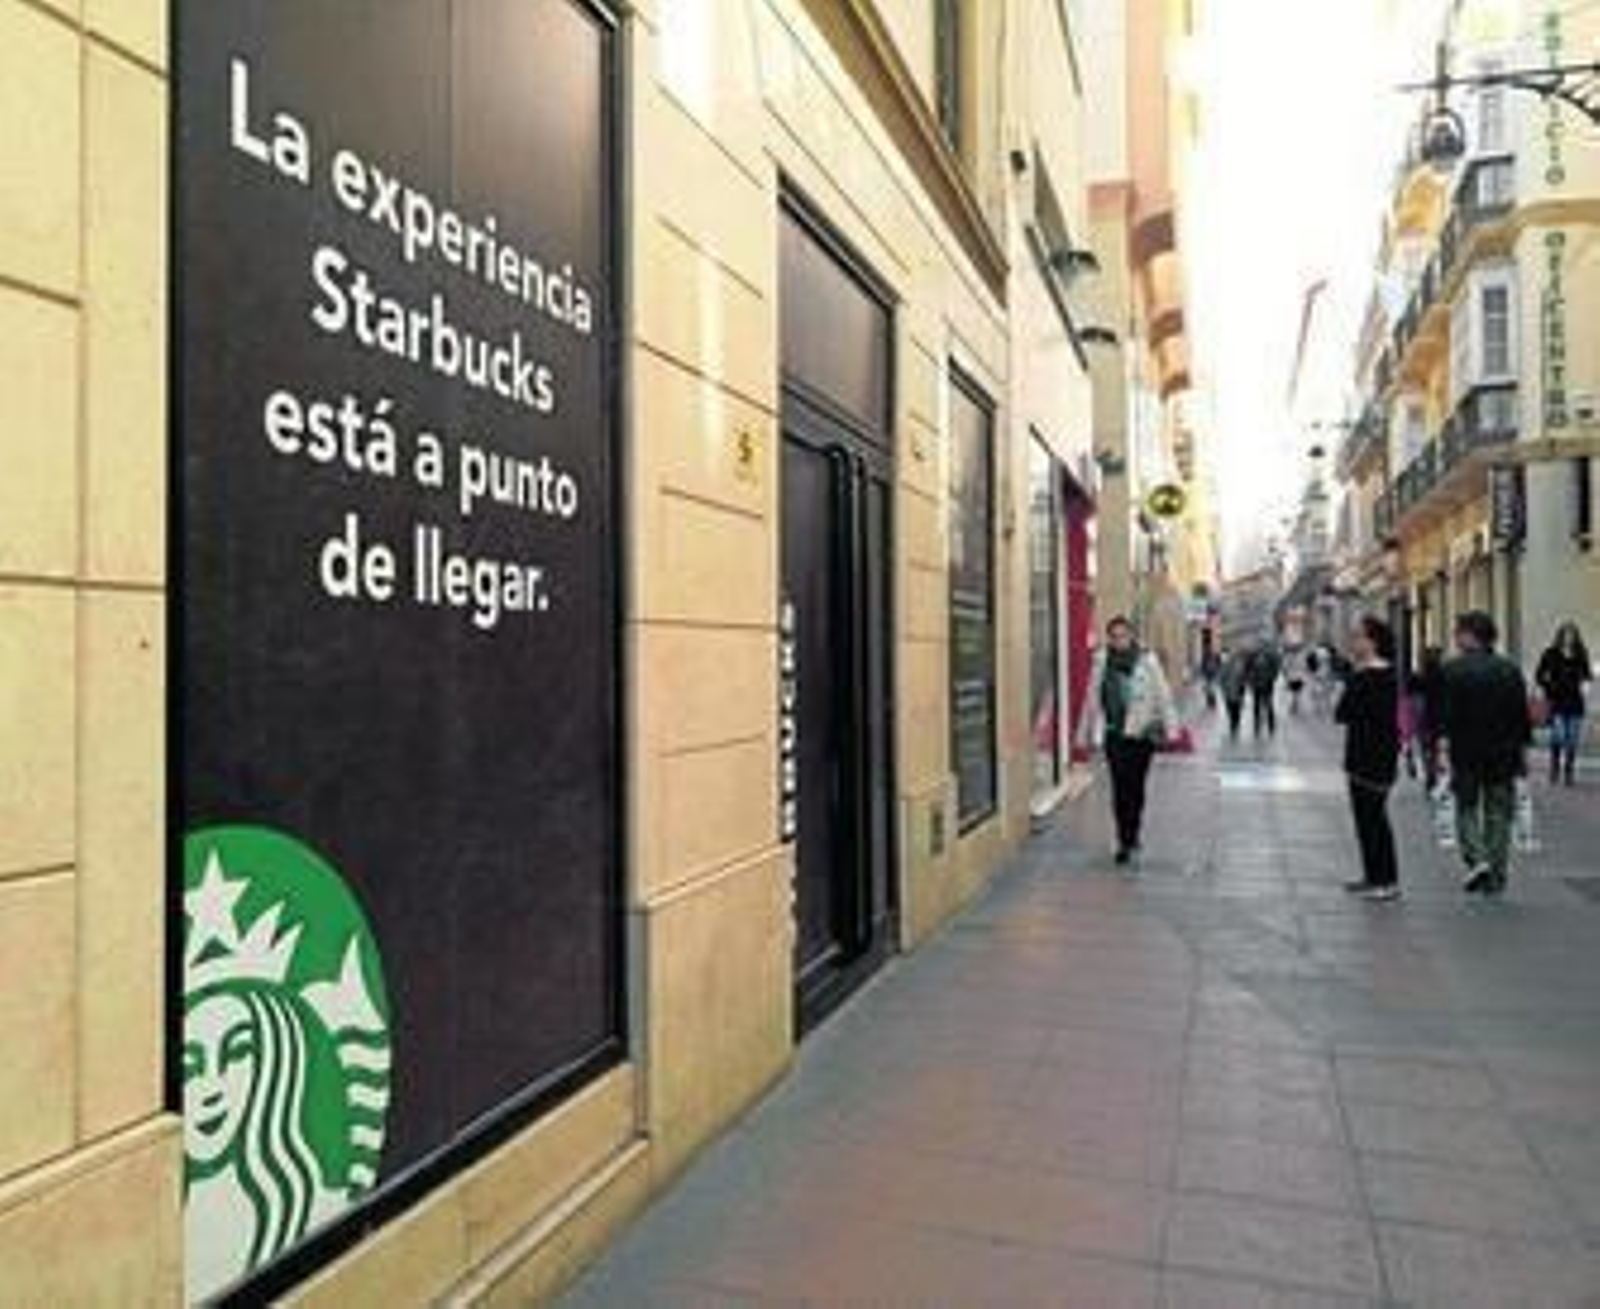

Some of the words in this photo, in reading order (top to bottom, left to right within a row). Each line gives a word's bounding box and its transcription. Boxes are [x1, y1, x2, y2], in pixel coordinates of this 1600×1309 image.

[231, 59, 309, 183] La
[332, 149, 593, 334] experiencia
[311, 245, 554, 412] Starbucks
[263, 389, 398, 477] está
[414, 433, 443, 487] a
[459, 444, 579, 518] punto
[319, 511, 396, 602] de
[414, 523, 550, 630] llegar.
